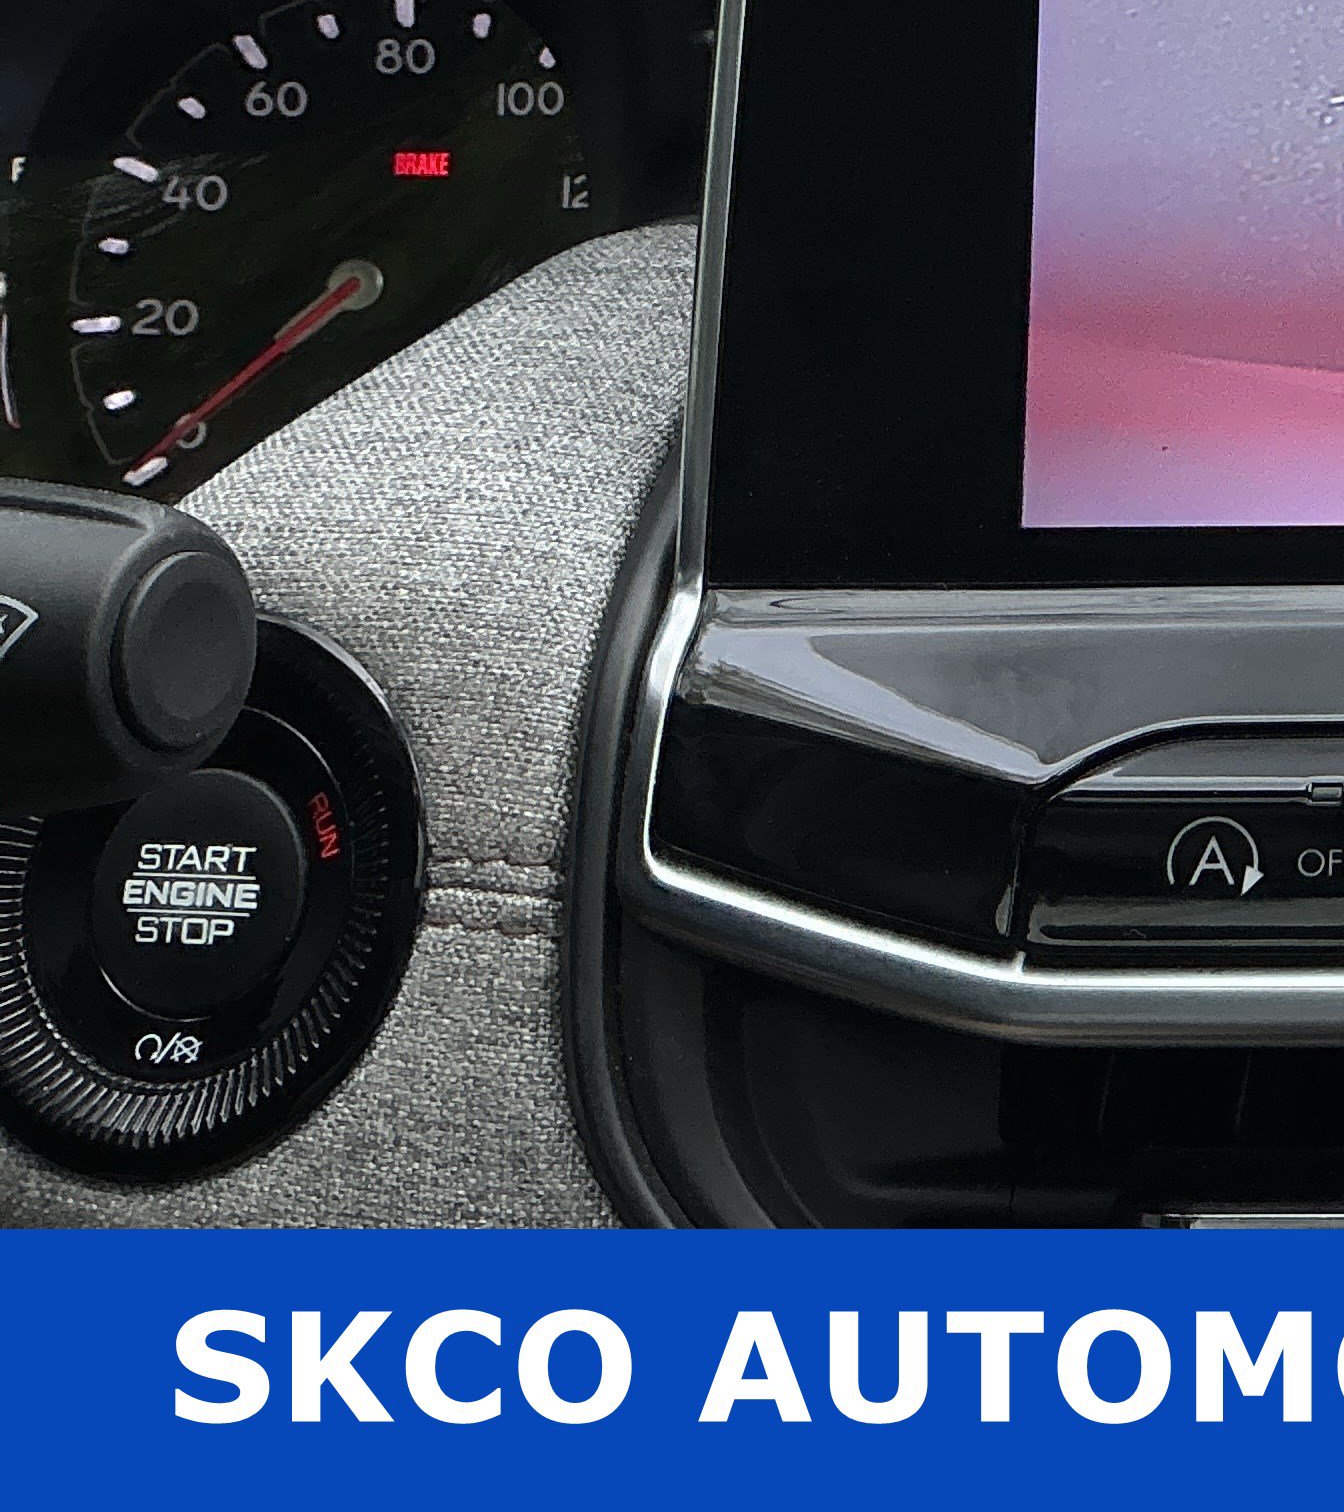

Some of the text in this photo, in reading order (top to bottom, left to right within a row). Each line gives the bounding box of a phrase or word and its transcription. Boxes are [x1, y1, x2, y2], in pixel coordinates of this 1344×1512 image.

[375, 38, 436, 75] 80
[245, 80, 308, 117] 60
[497, 81, 565, 117] 100
[11, 155, 27, 183] F
[393, 151, 451, 177] BRAKE
[162, 175, 228, 211] 40
[131, 298, 199, 336] 20
[309, 791, 341, 860] RUN
[137, 843, 258, 873] START
[122, 879, 261, 909] ENGINE
[134, 916, 235, 946] STOP
